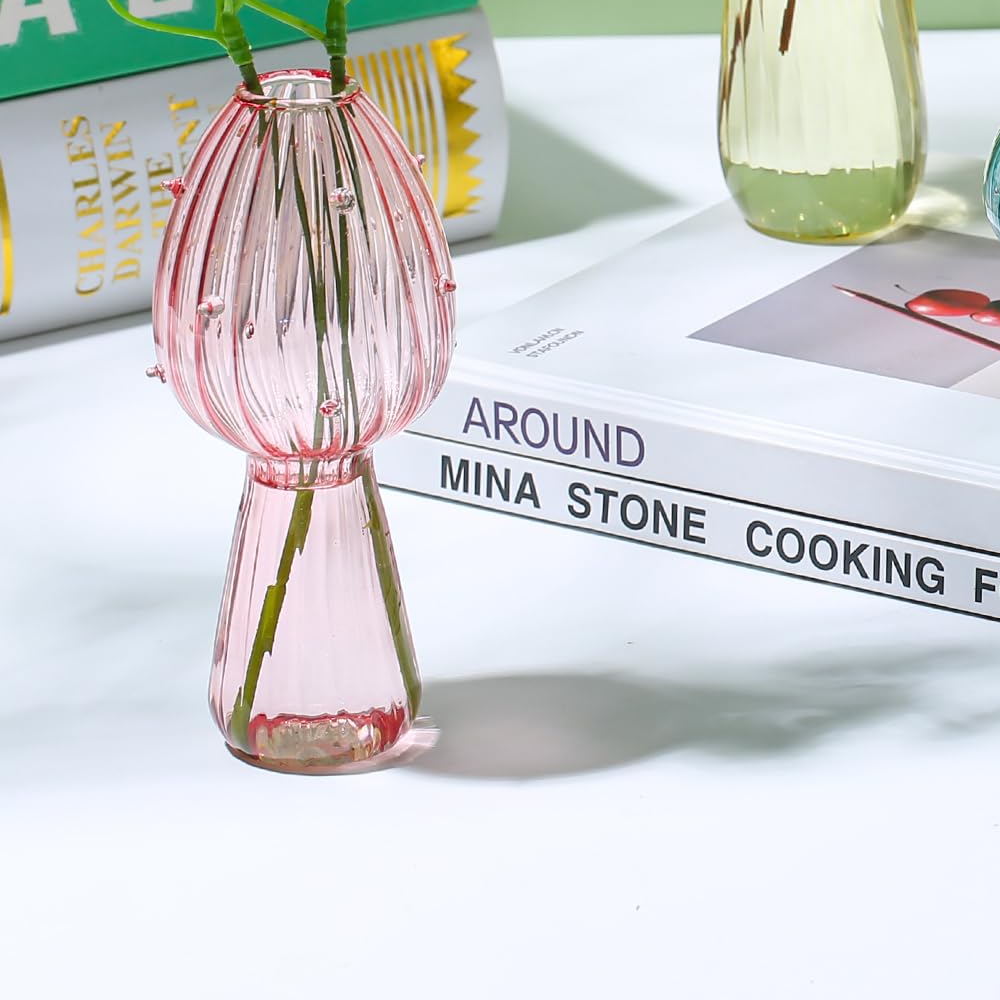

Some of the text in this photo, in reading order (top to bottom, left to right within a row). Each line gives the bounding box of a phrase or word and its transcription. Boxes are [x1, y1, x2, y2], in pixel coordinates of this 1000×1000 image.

[61, 114, 106, 297] CHARLES
[99, 120, 143, 283] DARWIN
[145, 152, 175, 238] THE
[462, 397, 646, 468] AROUND
[440, 454, 541, 509] MINA
[567, 482, 707, 545] STONE
[745, 520, 946, 596] COOKING
